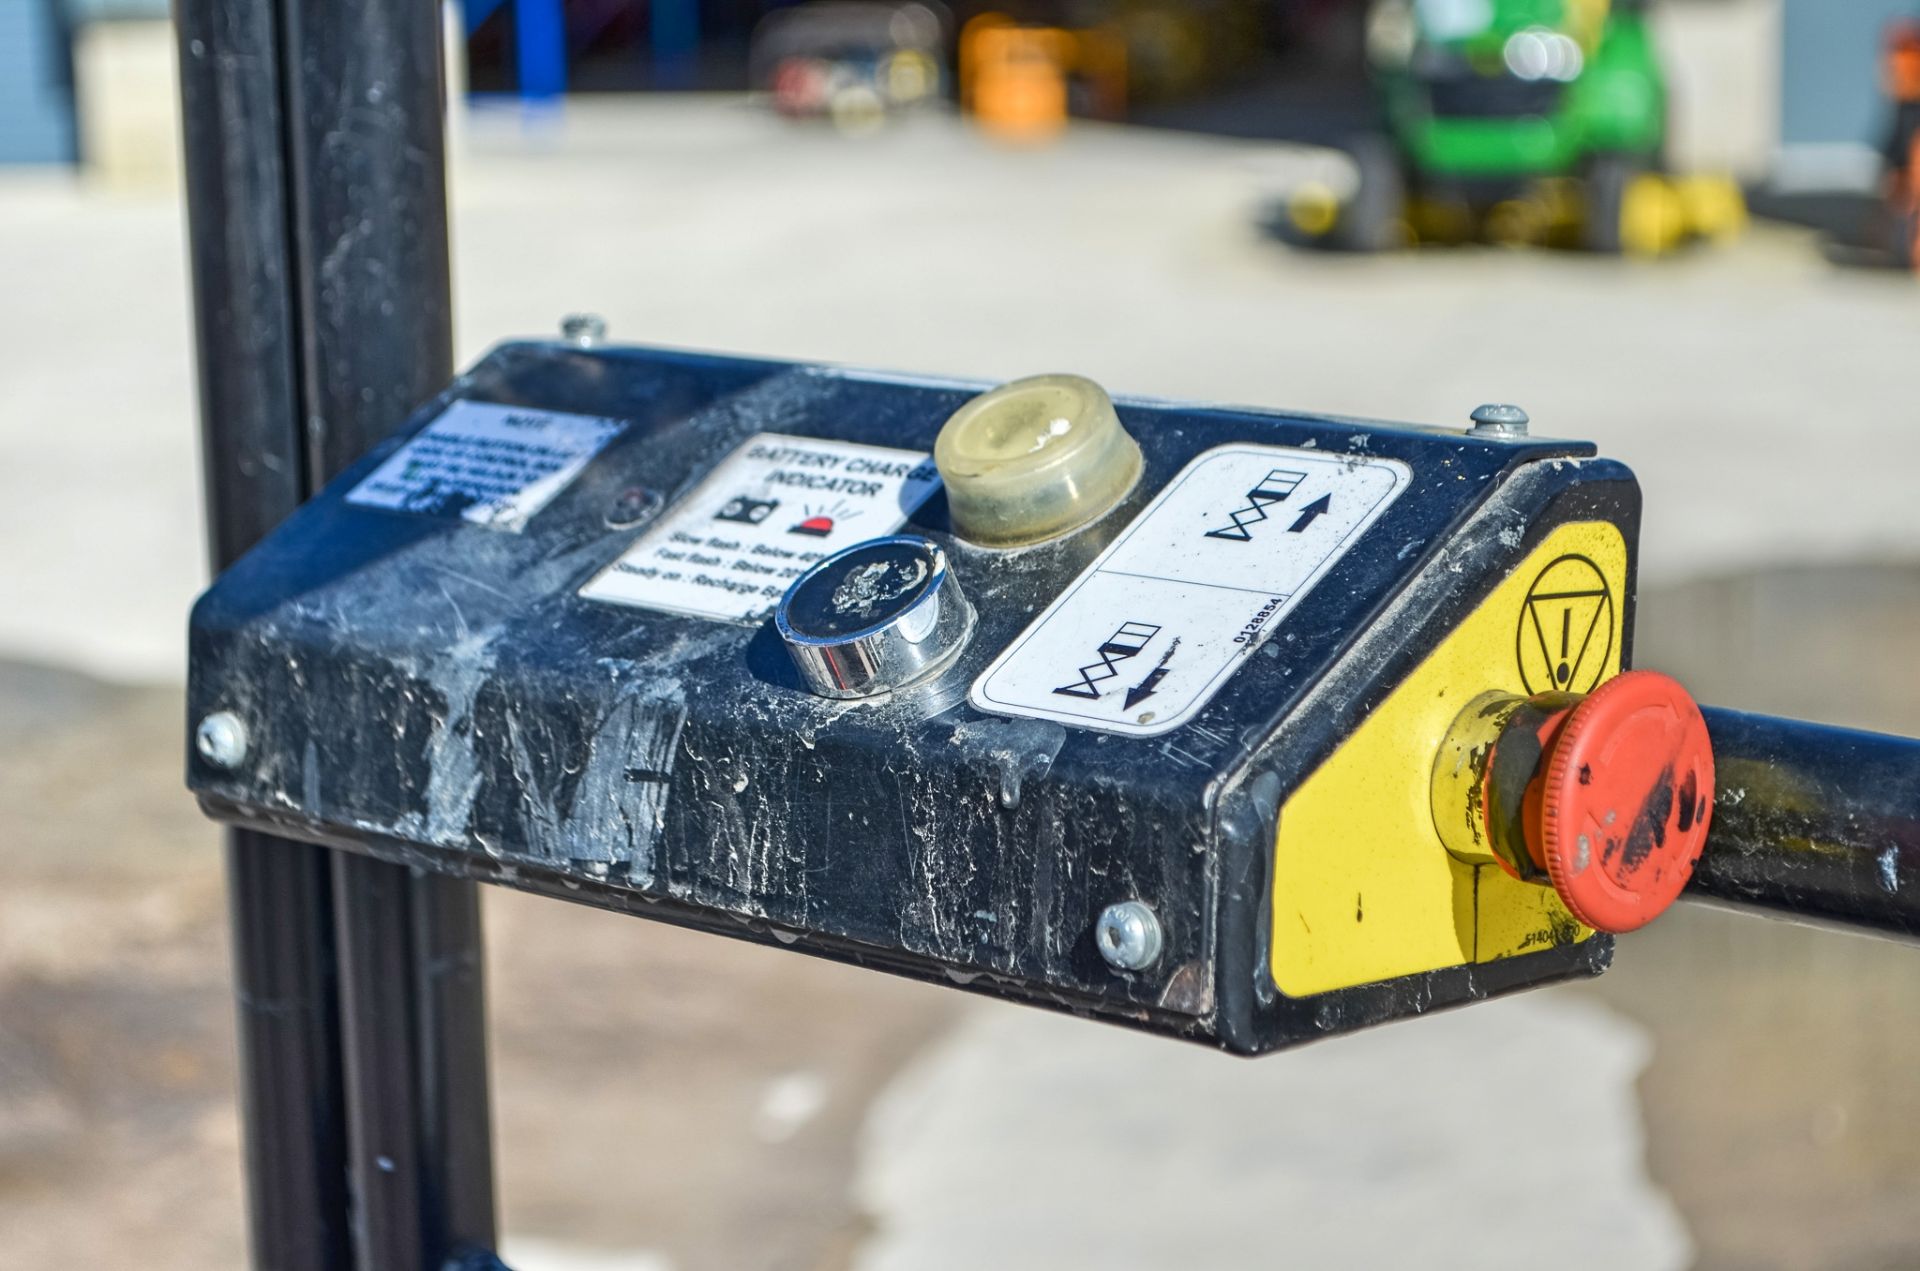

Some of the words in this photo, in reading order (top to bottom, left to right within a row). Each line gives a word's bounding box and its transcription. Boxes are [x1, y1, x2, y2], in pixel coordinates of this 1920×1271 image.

[747, 444, 844, 470] BATTERY
[846, 458, 938, 482] CHARGE
[765, 469, 883, 497] INDICATOR
[751, 543, 795, 558] Below
[732, 559, 777, 575] Below
[691, 573, 759, 595] Recharge
[1233, 598, 1283, 643] 0128854
